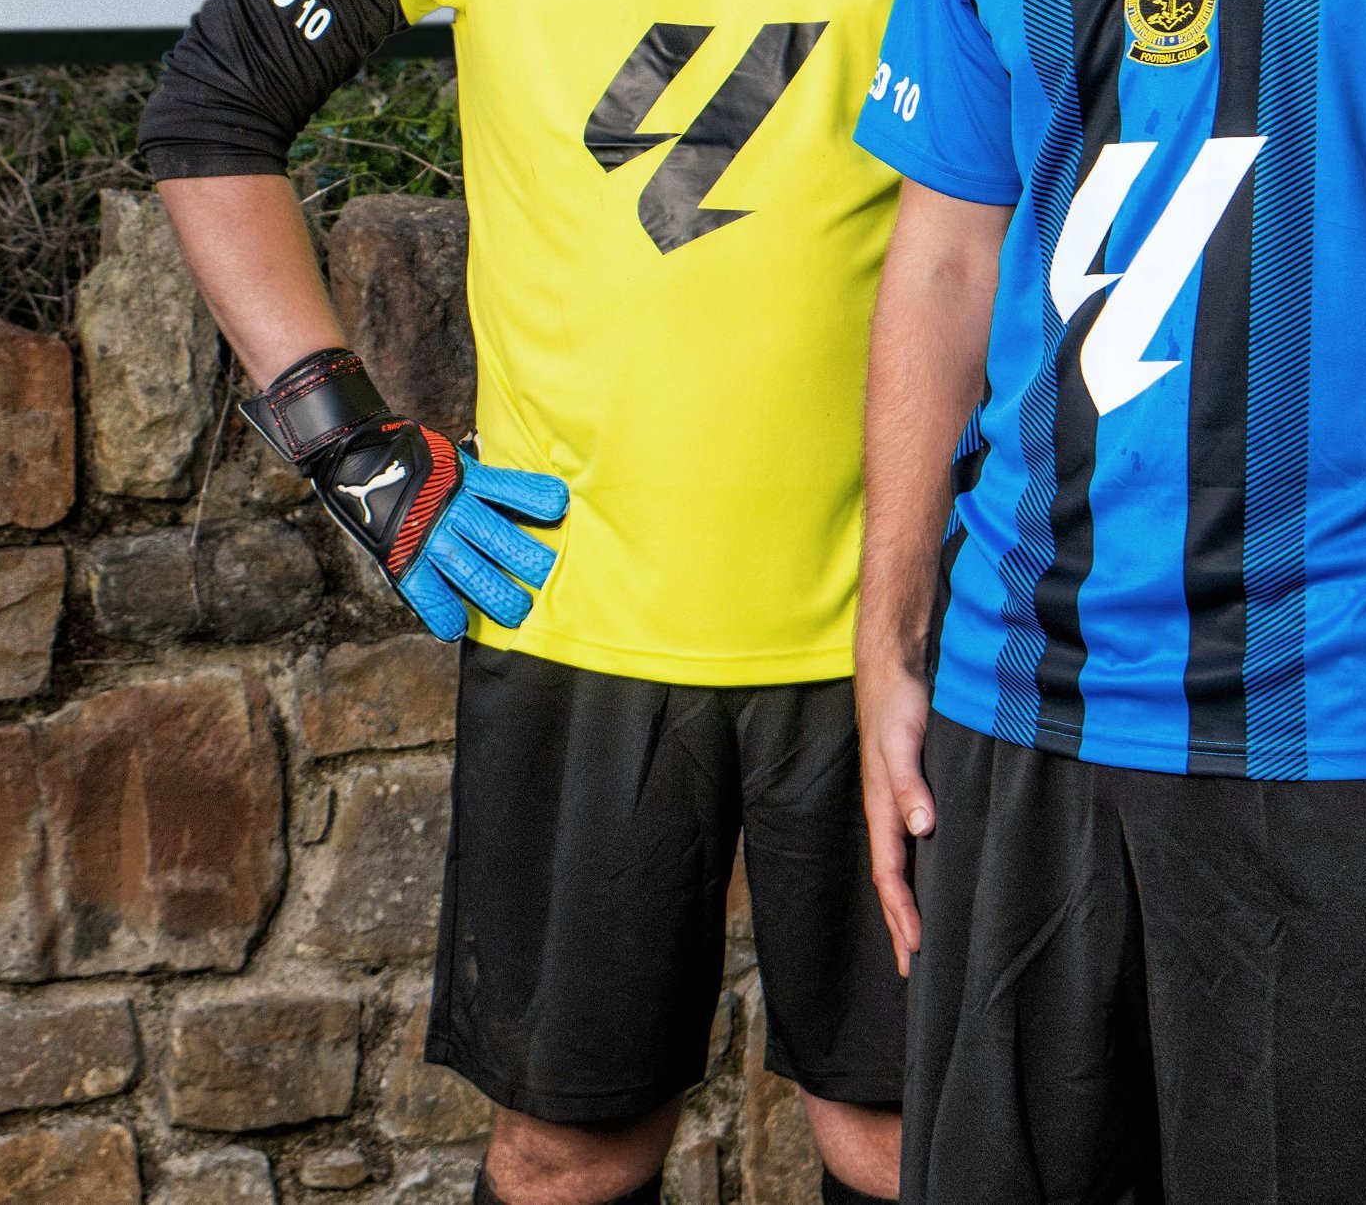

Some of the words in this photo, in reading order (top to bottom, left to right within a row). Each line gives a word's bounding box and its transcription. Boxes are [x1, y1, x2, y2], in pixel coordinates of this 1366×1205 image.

[295, 0, 332, 41] 10
[1140, 50, 1178, 63] FOOTBALL
[1178, 47, 1197, 61] CLUB
[893, 76, 920, 122] 10
